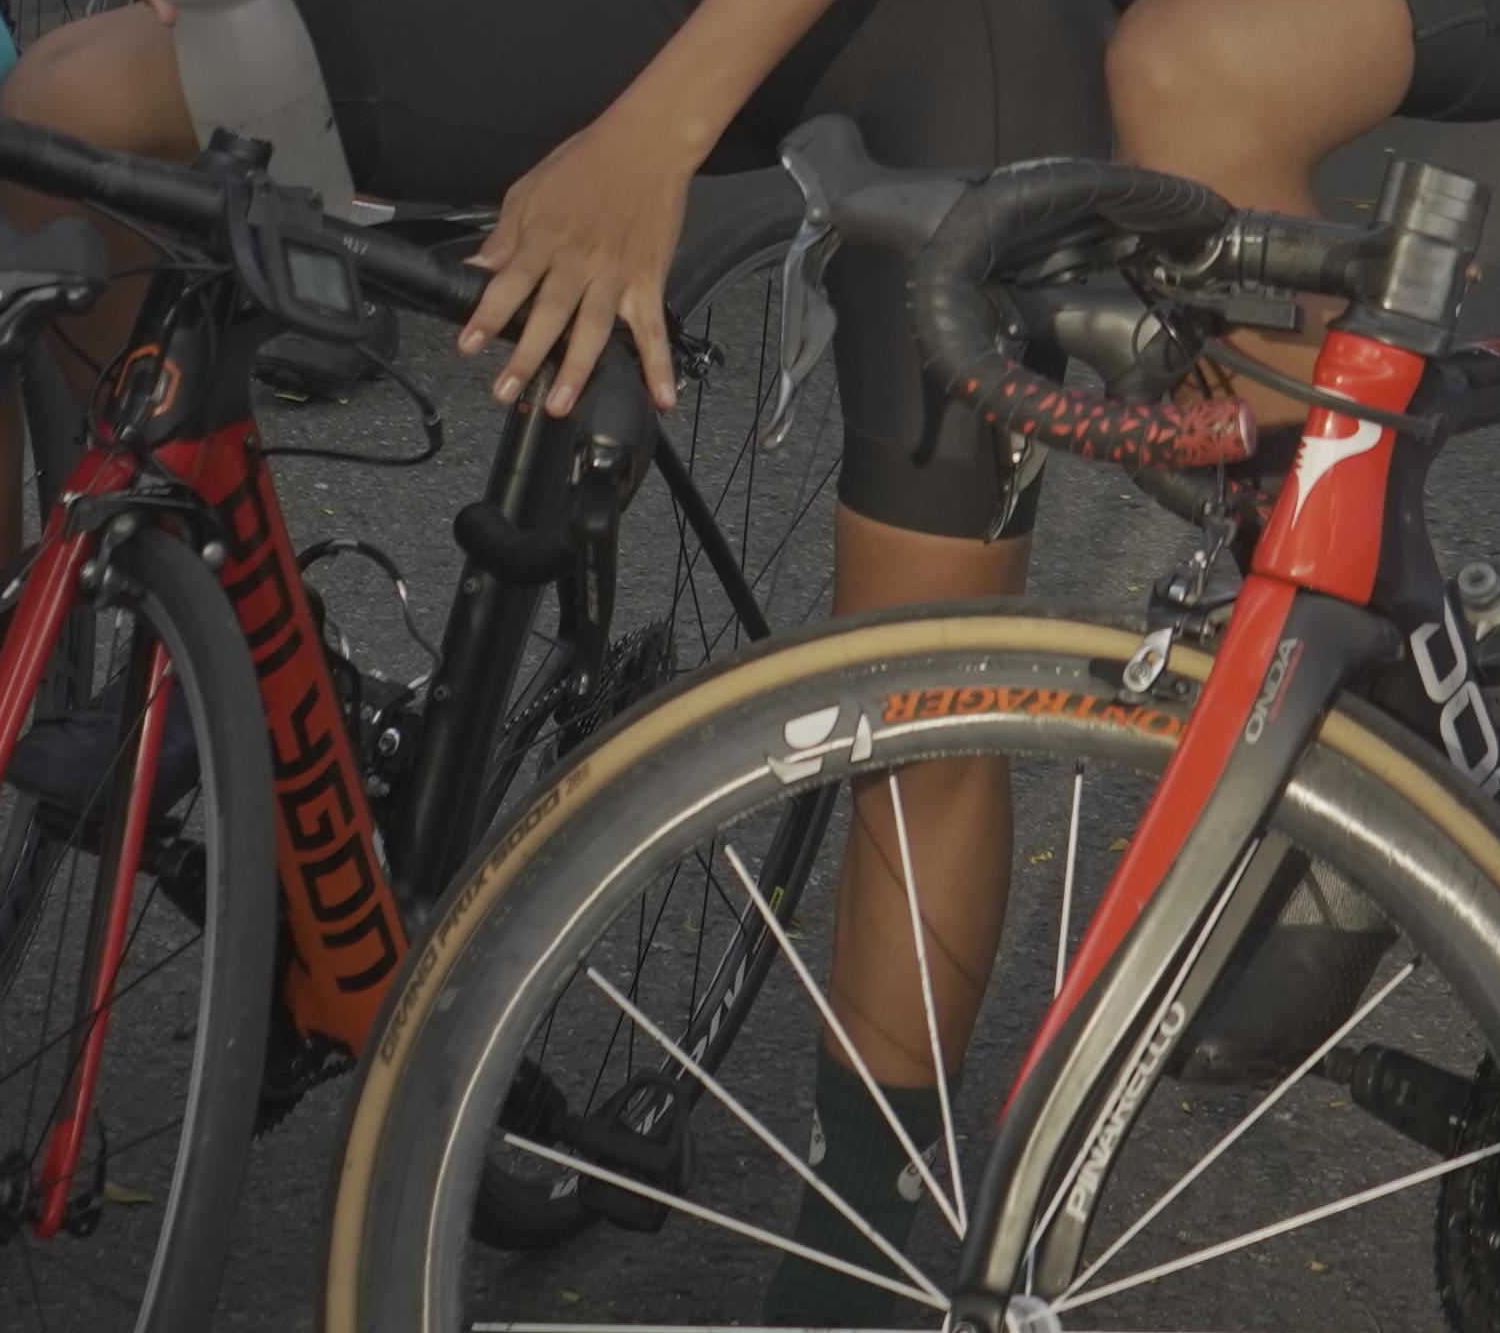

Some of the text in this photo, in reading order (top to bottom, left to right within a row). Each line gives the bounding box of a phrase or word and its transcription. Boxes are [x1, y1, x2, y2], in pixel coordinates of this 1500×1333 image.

[883, 684, 1184, 740] ONTRAGER
[1244, 637, 1298, 745] ONDA
[436, 870, 492, 944] PRIX
[1065, 1000, 1187, 1223] PINARELLO
